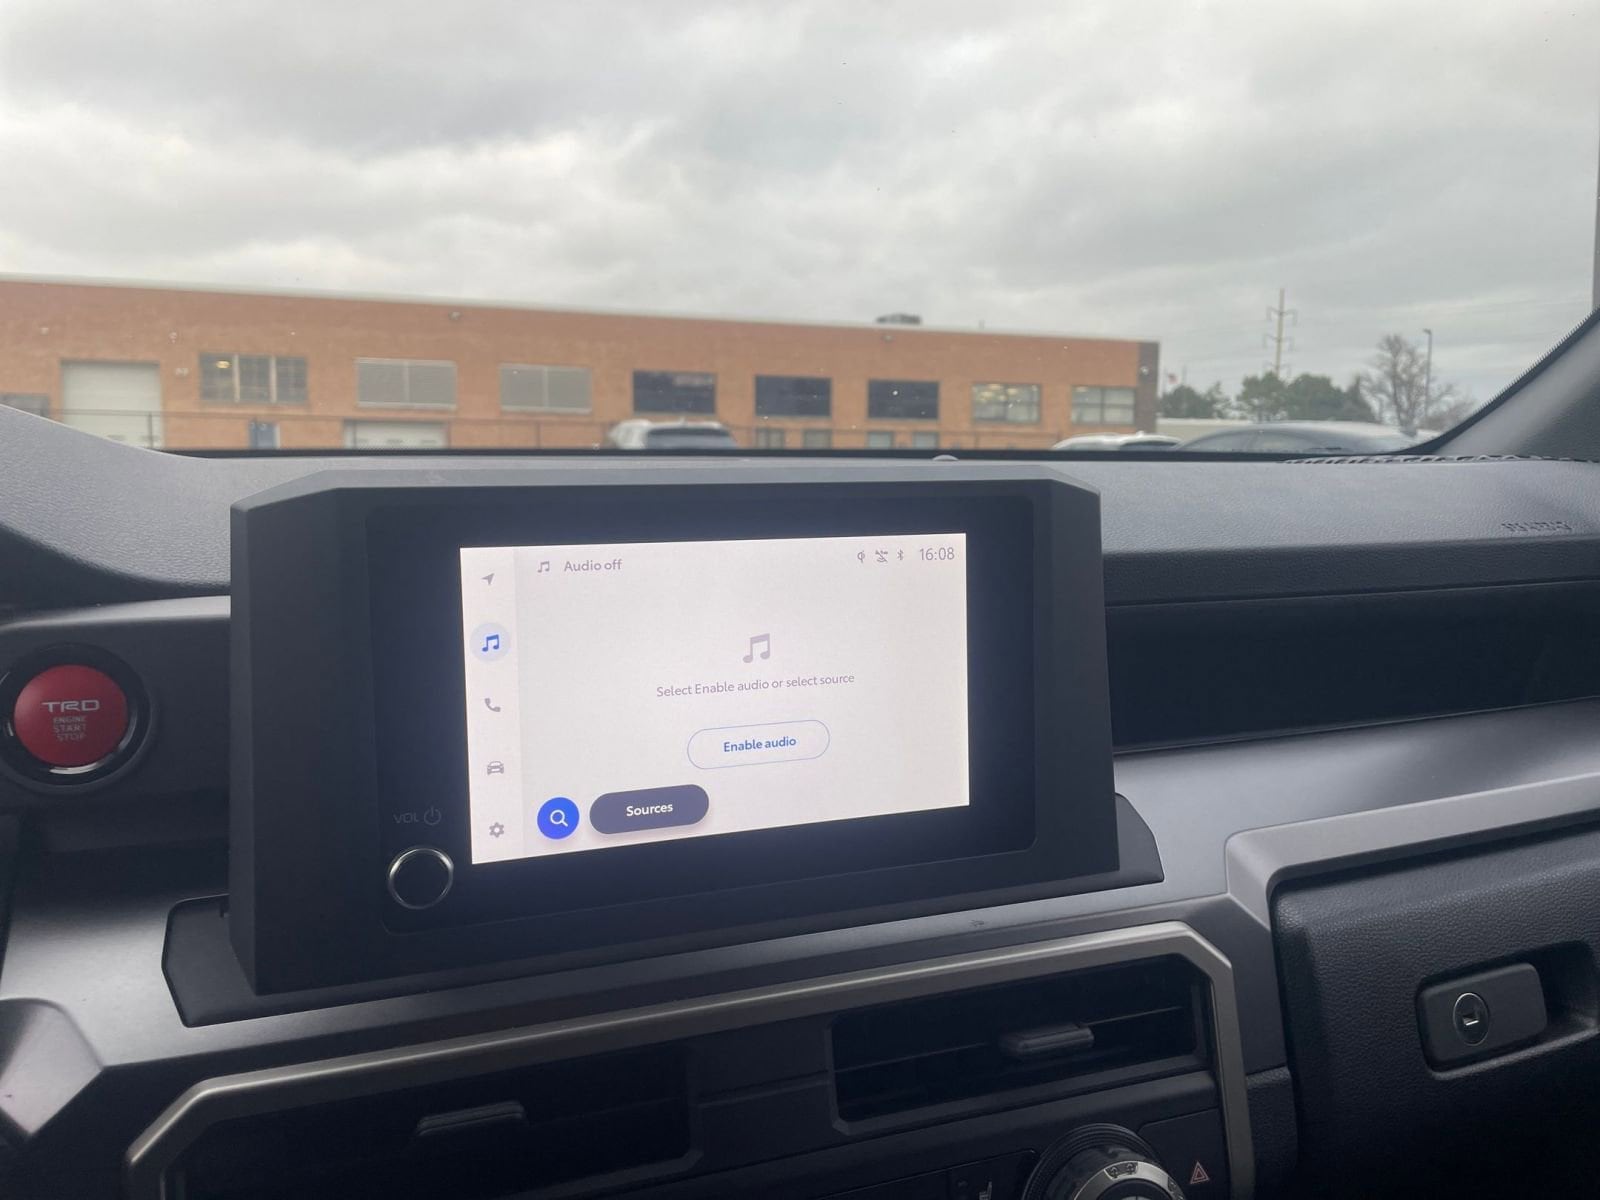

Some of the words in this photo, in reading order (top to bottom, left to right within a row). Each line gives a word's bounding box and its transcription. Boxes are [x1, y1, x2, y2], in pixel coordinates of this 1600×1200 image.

[919, 547, 955, 561] 16:08
[564, 560, 602, 571] Audio
[604, 559, 622, 570] off
[656, 685, 692, 697] Select
[695, 681, 735, 694] Enable
[737, 679, 769, 691] audio
[771, 680, 784, 689] or
[786, 676, 818, 688] select
[820, 675, 855, 685] source
[42, 700, 100, 712] TRD
[53, 724, 86, 733] START
[723, 740, 763, 752] Enable
[764, 736, 797, 749] audio
[626, 804, 673, 817] Sources
[393, 812, 419, 823] VOL
